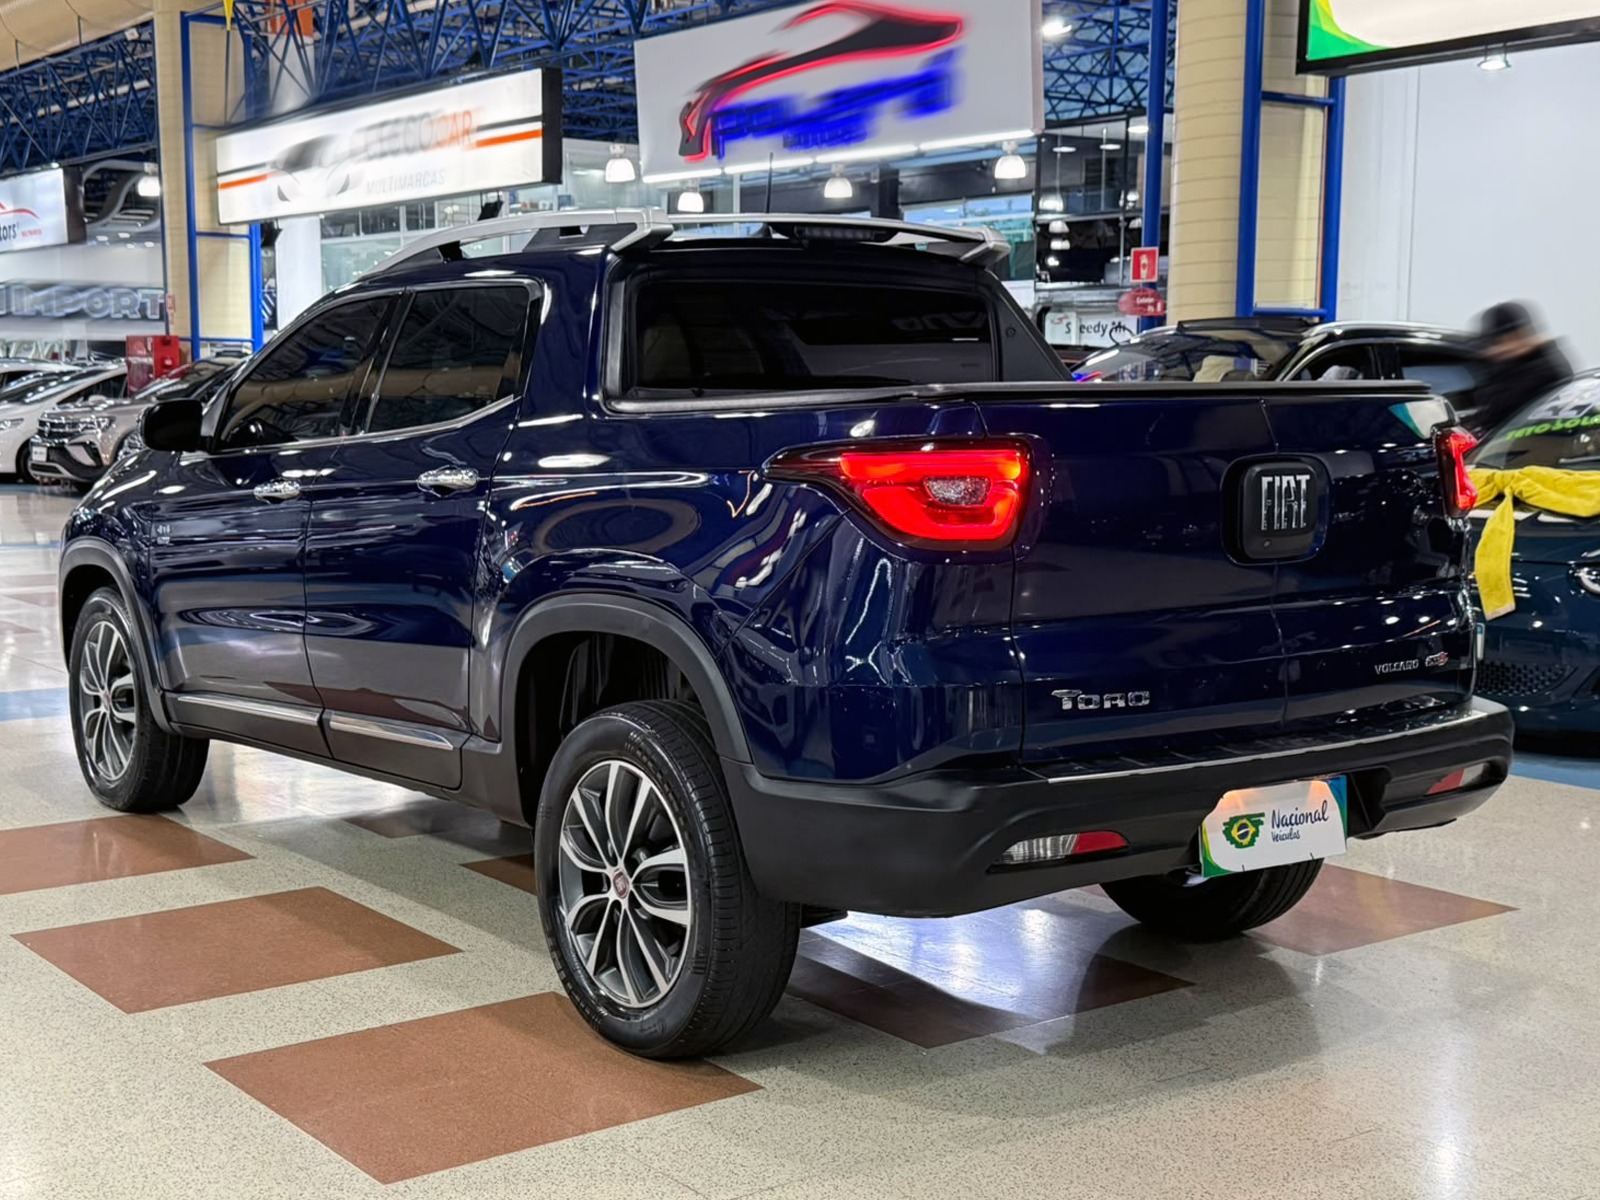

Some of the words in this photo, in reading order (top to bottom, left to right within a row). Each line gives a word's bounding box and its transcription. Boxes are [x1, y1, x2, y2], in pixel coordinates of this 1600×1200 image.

[365, 169, 446, 194] MULTIMARCAS
[11, 285, 164, 319] IMPORT
[1064, 321, 1109, 337] Seedy
[1261, 474, 1310, 531] FIAT
[1271, 799, 1329, 829] Nacional
